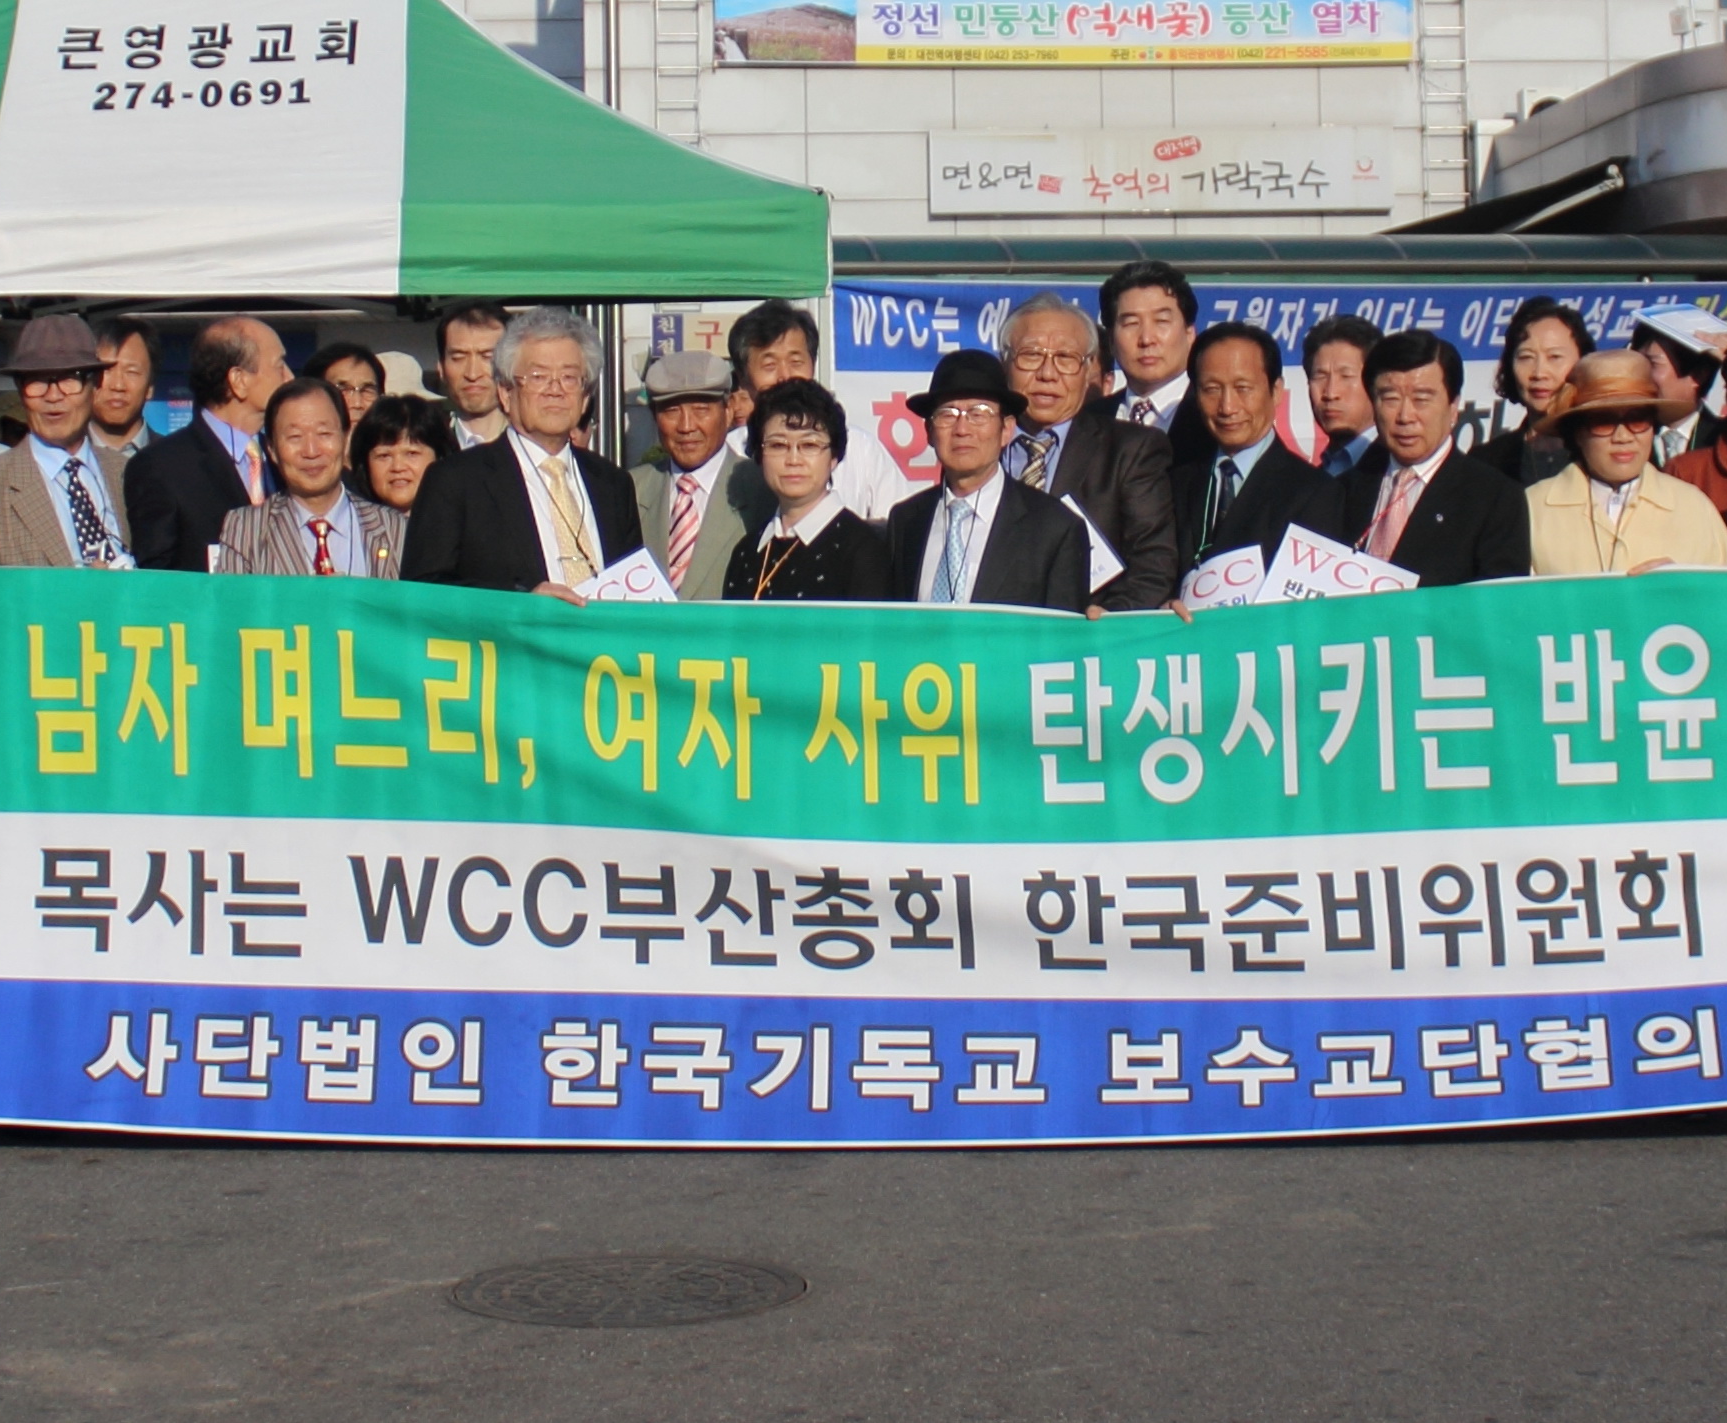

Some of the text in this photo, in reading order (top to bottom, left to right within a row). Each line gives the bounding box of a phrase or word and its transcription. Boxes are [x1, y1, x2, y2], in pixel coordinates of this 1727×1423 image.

[873, 2, 941, 37] 정선
[1222, 1, 1293, 36] 등산
[1311, 0, 1380, 34] 열차
[91, 78, 312, 111] 274-0691
[942, 160, 1034, 191] 면&면
[1082, 163, 1171, 204] 추억의
[1181, 159, 1331, 200] 가락국수
[849, 294, 961, 354] WCC는
[27, 619, 199, 778] 남자
[237, 624, 539, 793] 며느리,
[582, 651, 762, 802] 여자
[803, 659, 981, 807] 사위
[1027, 634, 1496, 808] 탄생시키는
[34, 846, 309, 959] 목사는
[348, 853, 977, 971] WCC부산총회
[1024, 849, 1704, 975] 한국준비위원회
[84, 1007, 487, 1106] 사단법인
[541, 1019, 1048, 1113] 한국기독교
